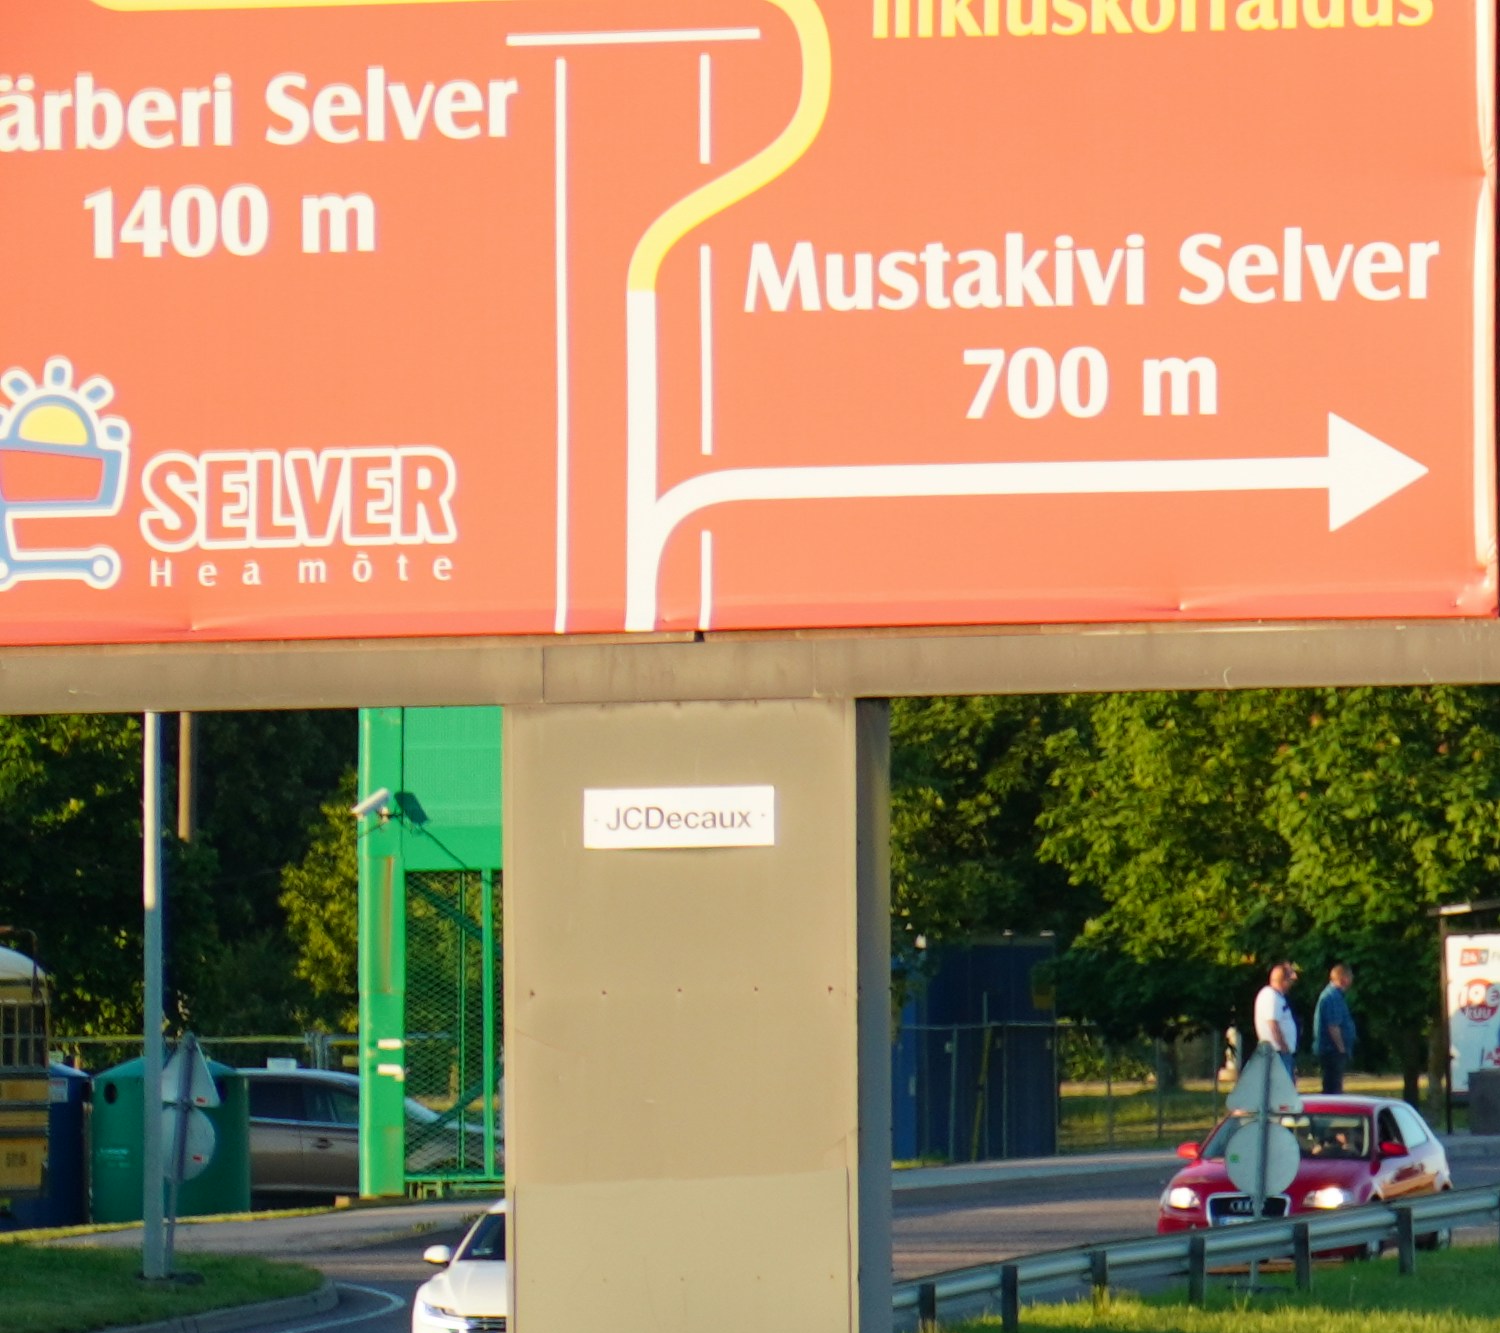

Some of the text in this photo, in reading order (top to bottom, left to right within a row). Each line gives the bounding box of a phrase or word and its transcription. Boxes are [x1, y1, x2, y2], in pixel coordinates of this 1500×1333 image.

[264, 65, 519, 146] Selver
[83, 183, 377, 260] 1400 m
[744, 226, 1440, 313] Mustakivi Selver
[963, 346, 1218, 419] 700 m
[139, 445, 458, 553] SELVER
[606, 806, 752, 832] JCDecaux
